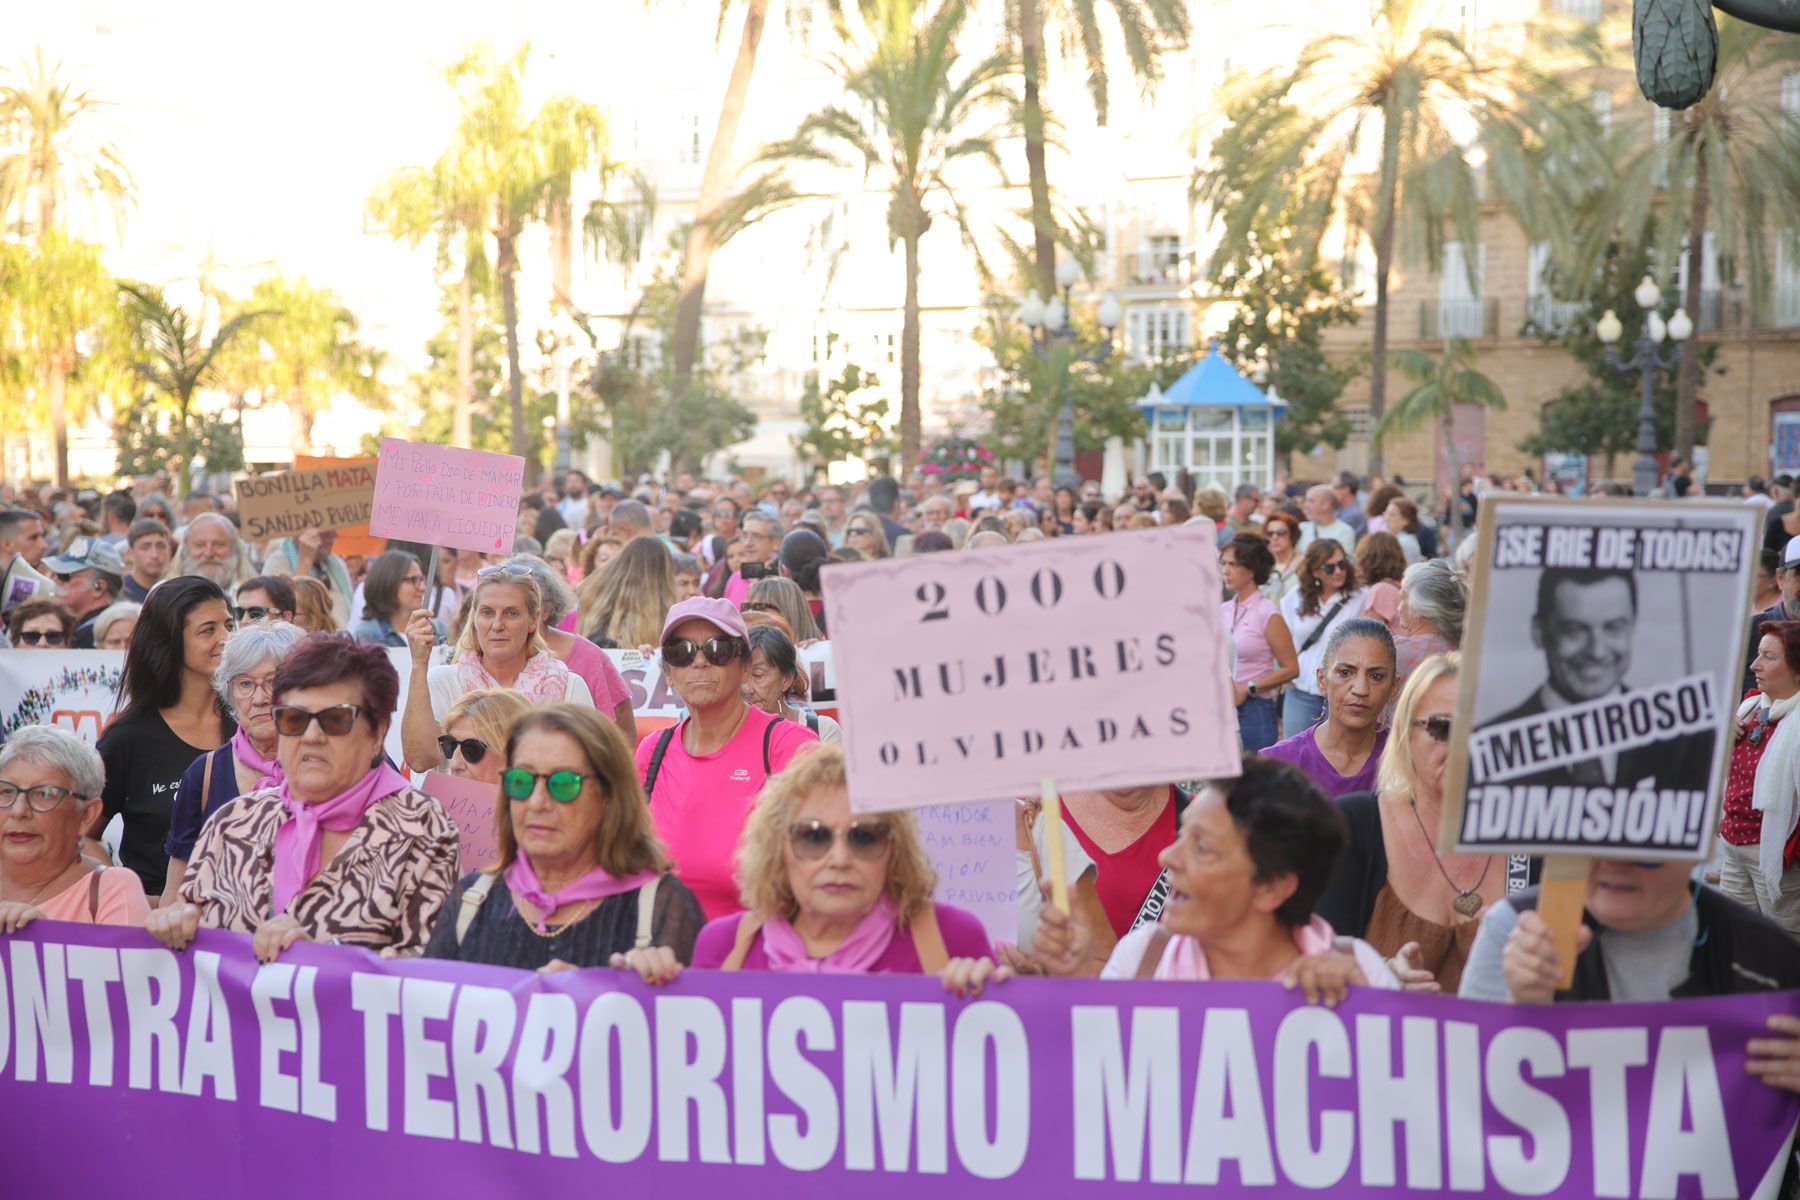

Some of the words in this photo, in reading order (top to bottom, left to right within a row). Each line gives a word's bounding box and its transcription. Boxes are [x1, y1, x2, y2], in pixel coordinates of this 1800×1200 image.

[240, 473, 325, 498] BONILLA
[326, 466, 375, 488] MATA
[294, 493, 312, 505] LA
[381, 480, 391, 494] Y
[395, 480, 423, 498] POR
[425, 484, 456, 503] FALTA
[460, 489, 474, 505] DE
[478, 491, 520, 509] DINERO
[463, 468, 475, 480] DE
[480, 470, 521, 487] MAMAR
[377, 503, 401, 526] ME
[406, 509, 429, 529] VAN
[432, 512, 441, 530] A
[447, 516, 514, 539] LIQUIDAR
[1495, 526, 1544, 567] ¡SE
[1545, 527, 1594, 568] RIE
[1595, 528, 1637, 569] DE
[1639, 530, 1741, 571] TODAS!
[915, 560, 1126, 623] 2000
[893, 633, 1177, 701] MUJERES
[879, 707, 1191, 767] OLVIDADAS
[1476, 681, 1714, 778] ¡MENTIROSO!
[1463, 775, 1705, 842] ¡DIMISIÓN!
[918, 830, 1003, 848] AMBIEN
[0, 939, 238, 1102] NTRA
[251, 962, 338, 1123] EL
[351, 971, 1031, 1180] TERRORISMO
[1071, 1004, 1740, 1200] MACHISTA
